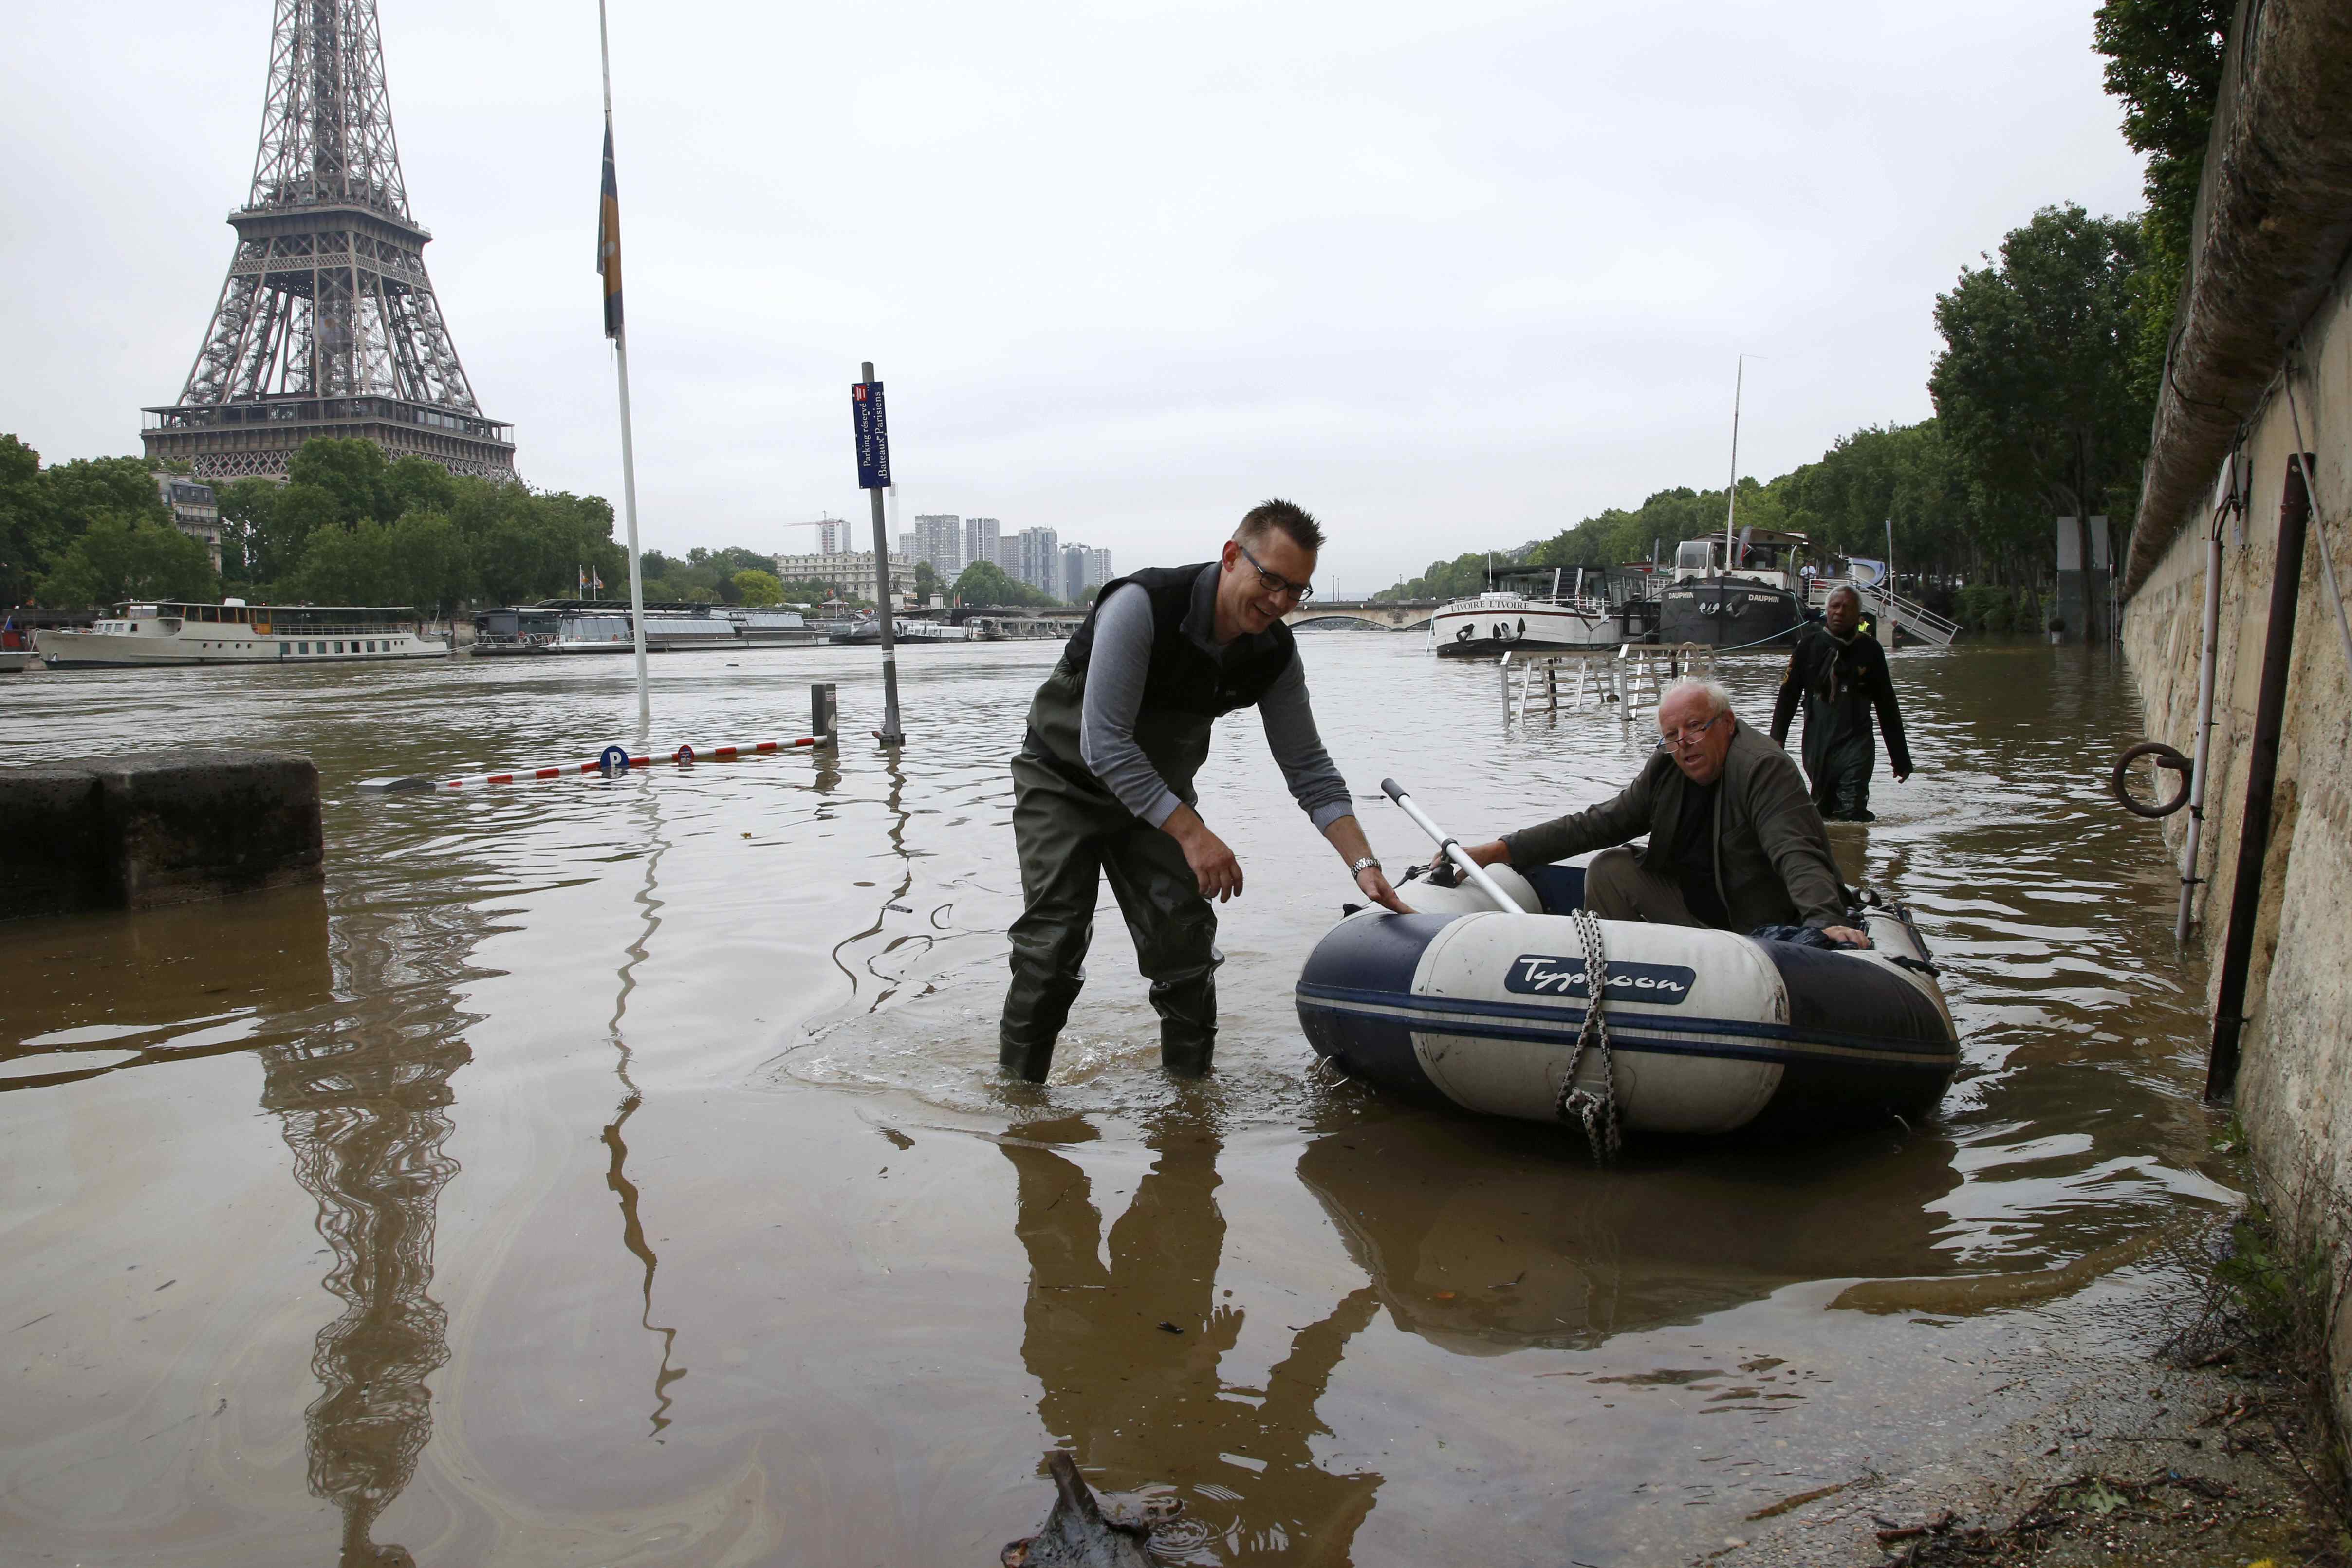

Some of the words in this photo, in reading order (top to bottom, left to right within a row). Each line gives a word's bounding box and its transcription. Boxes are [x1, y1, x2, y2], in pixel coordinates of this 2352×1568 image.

[859, 403, 868, 432] réservé
[873, 391, 884, 434] Parisiens
[862, 435, 871, 467] Parking
[878, 439, 887, 477] Bateaux
[1450, 600, 1485, 612] L'IVOIRE
[1490, 601, 1530, 609] L'IVOIRE
[1748, 594, 1779, 603] DAUPHIN
[609, 751, 622, 767] P
[1519, 958, 1685, 992] Typoon
